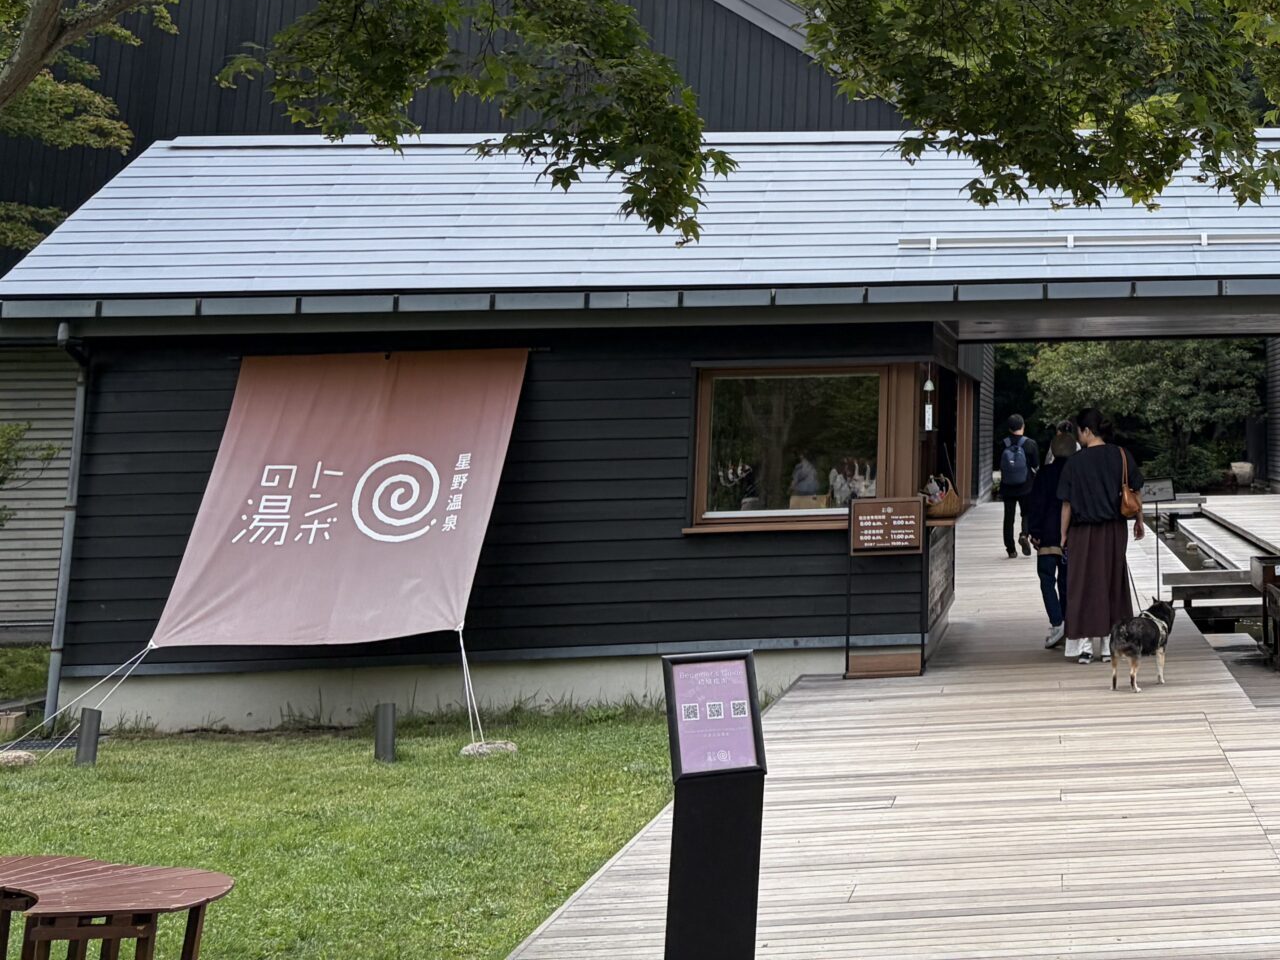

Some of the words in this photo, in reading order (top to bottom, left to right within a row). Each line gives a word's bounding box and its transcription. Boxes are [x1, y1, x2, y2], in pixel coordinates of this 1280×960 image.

[231, 464, 298, 546] の湯
[294, 460, 344, 545] トンボ
[441, 452, 472, 532] 星野温泉
